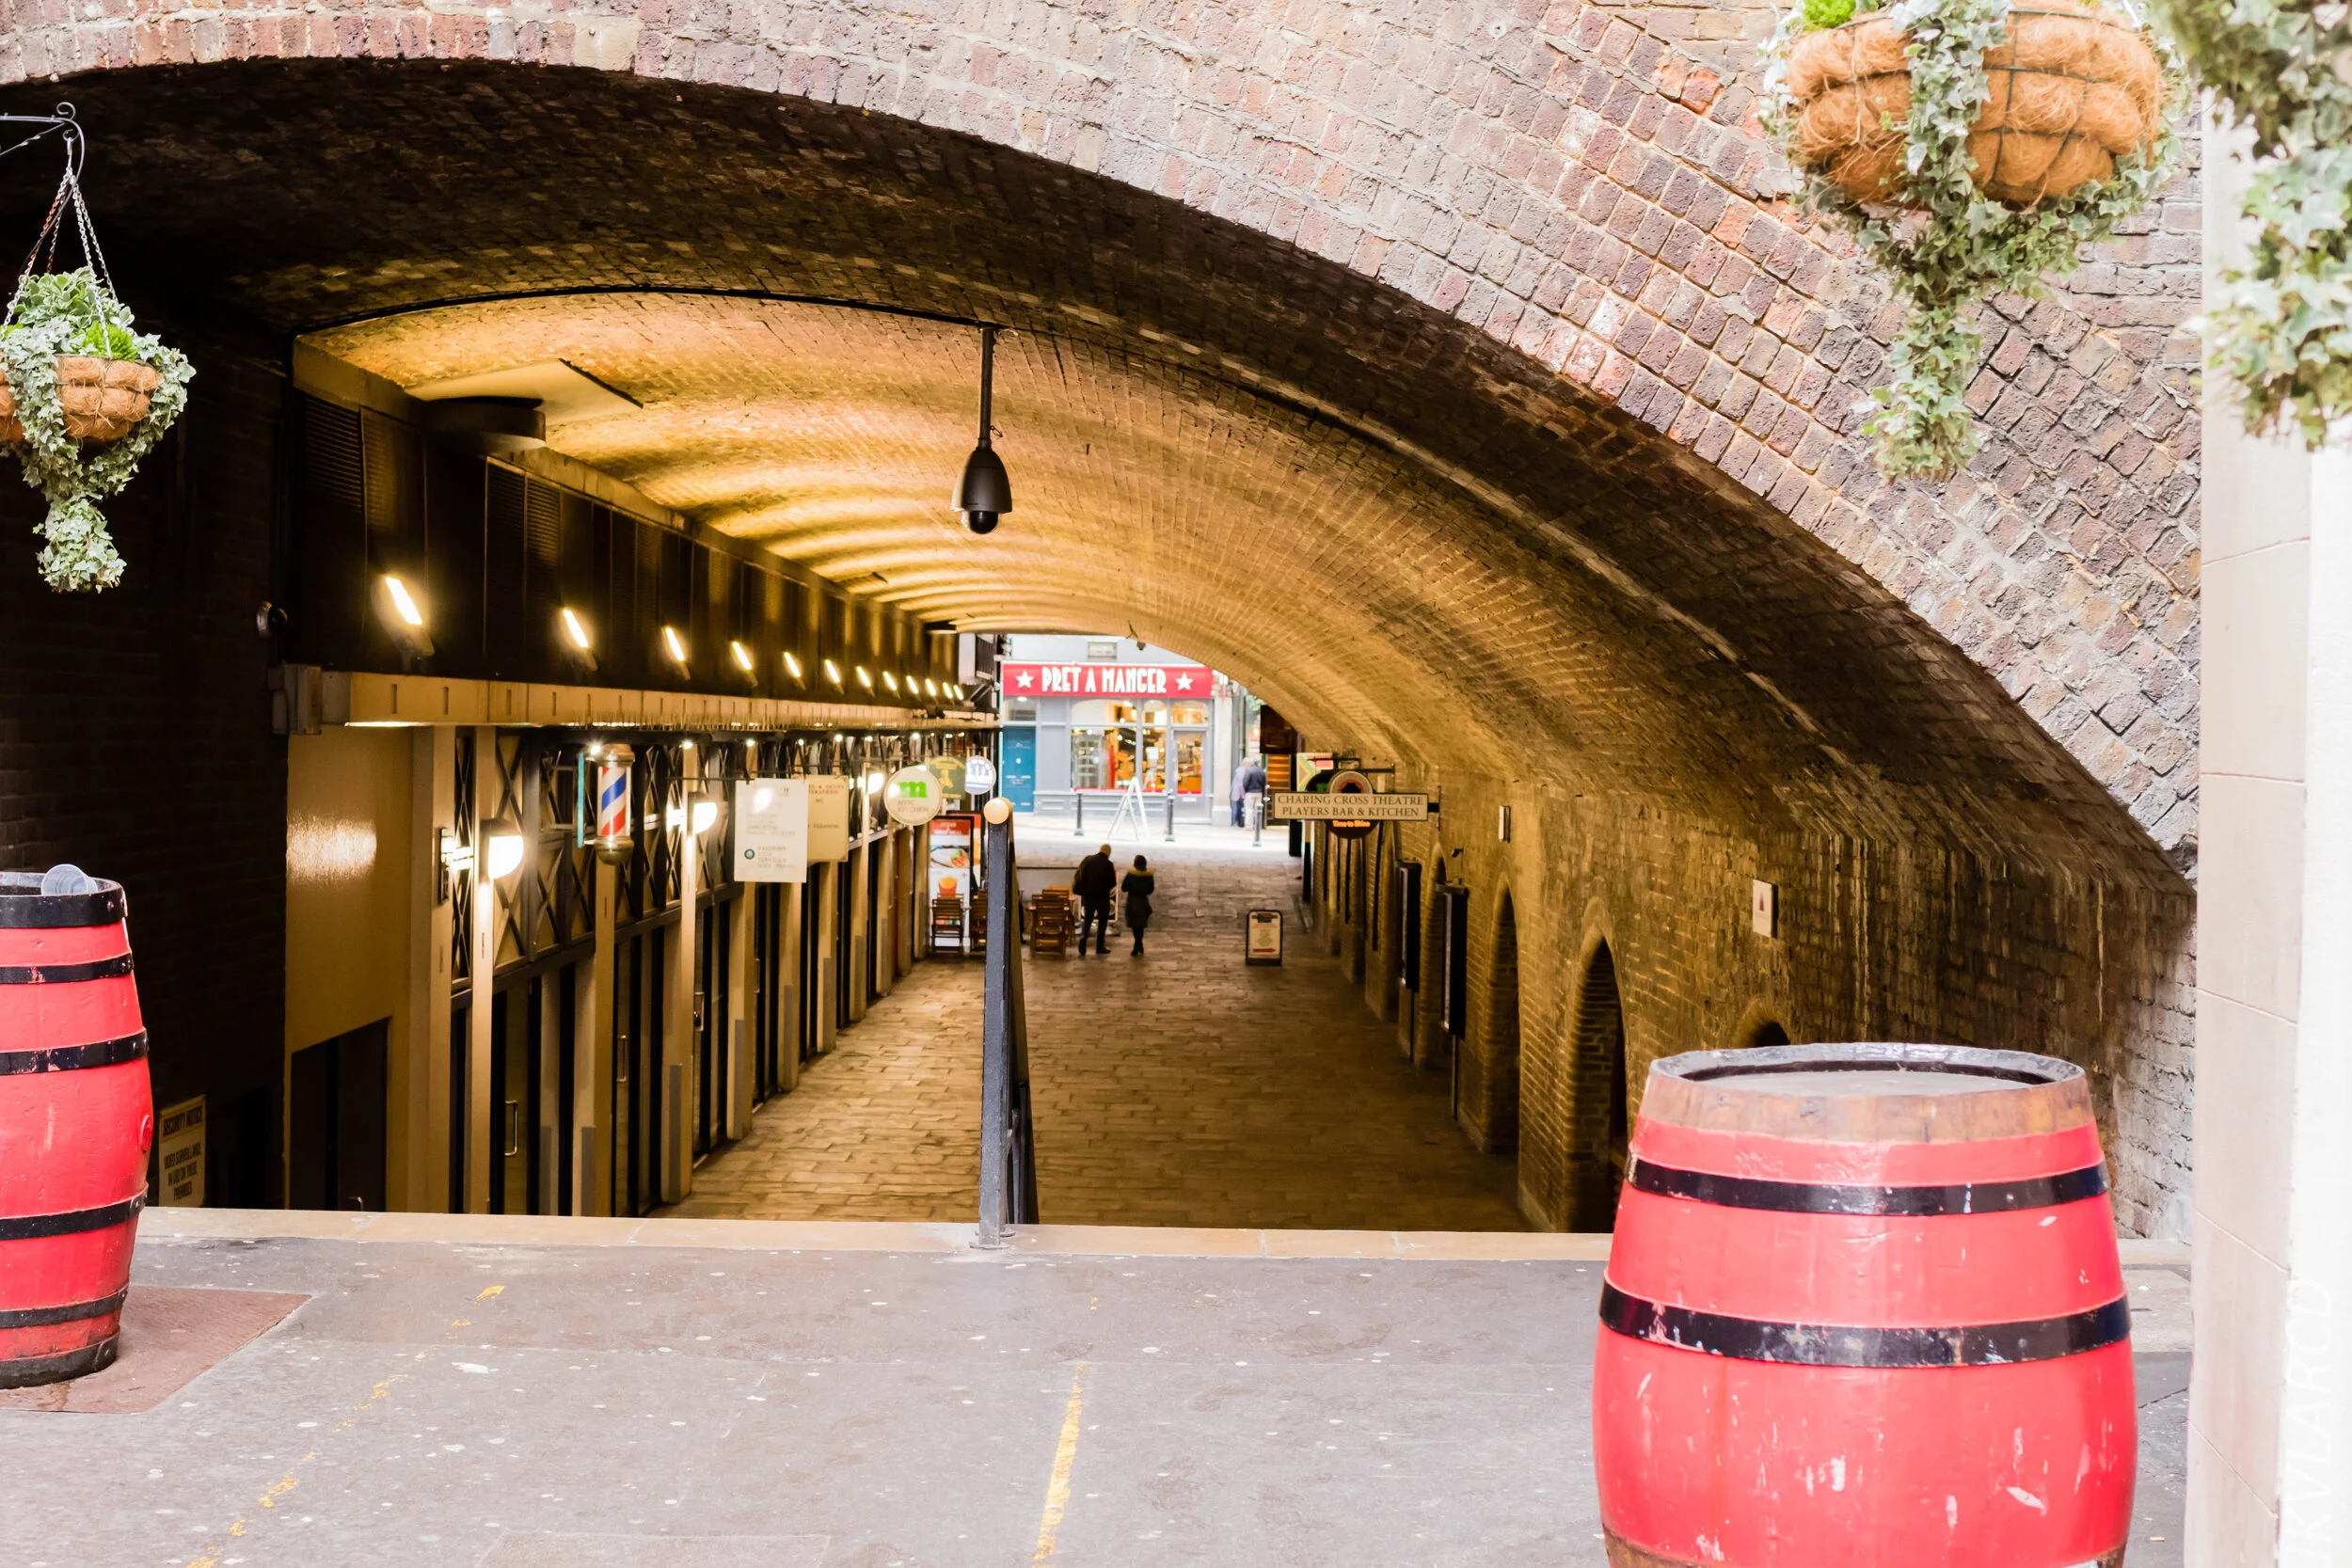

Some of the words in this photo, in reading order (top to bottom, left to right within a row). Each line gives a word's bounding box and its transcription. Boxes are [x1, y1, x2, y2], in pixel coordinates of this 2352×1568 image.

[1041, 666, 1082, 692] PRET
[1085, 667, 1097, 693] A
[1102, 667, 1168, 694] MANGER
[1278, 795, 1331, 805] CHARING
[1334, 795, 1370, 805] CROSS
[1372, 795, 1423, 806] THEATRE
[1282, 806, 1329, 816] PLAYERS
[1332, 807, 1356, 816] BAR
[1357, 807, 1364, 816] &
[1368, 807, 1420, 817] KITCHEN
[163, 1112, 185, 1138] SECURITY
[186, 1105, 203, 1128] NOTICE
